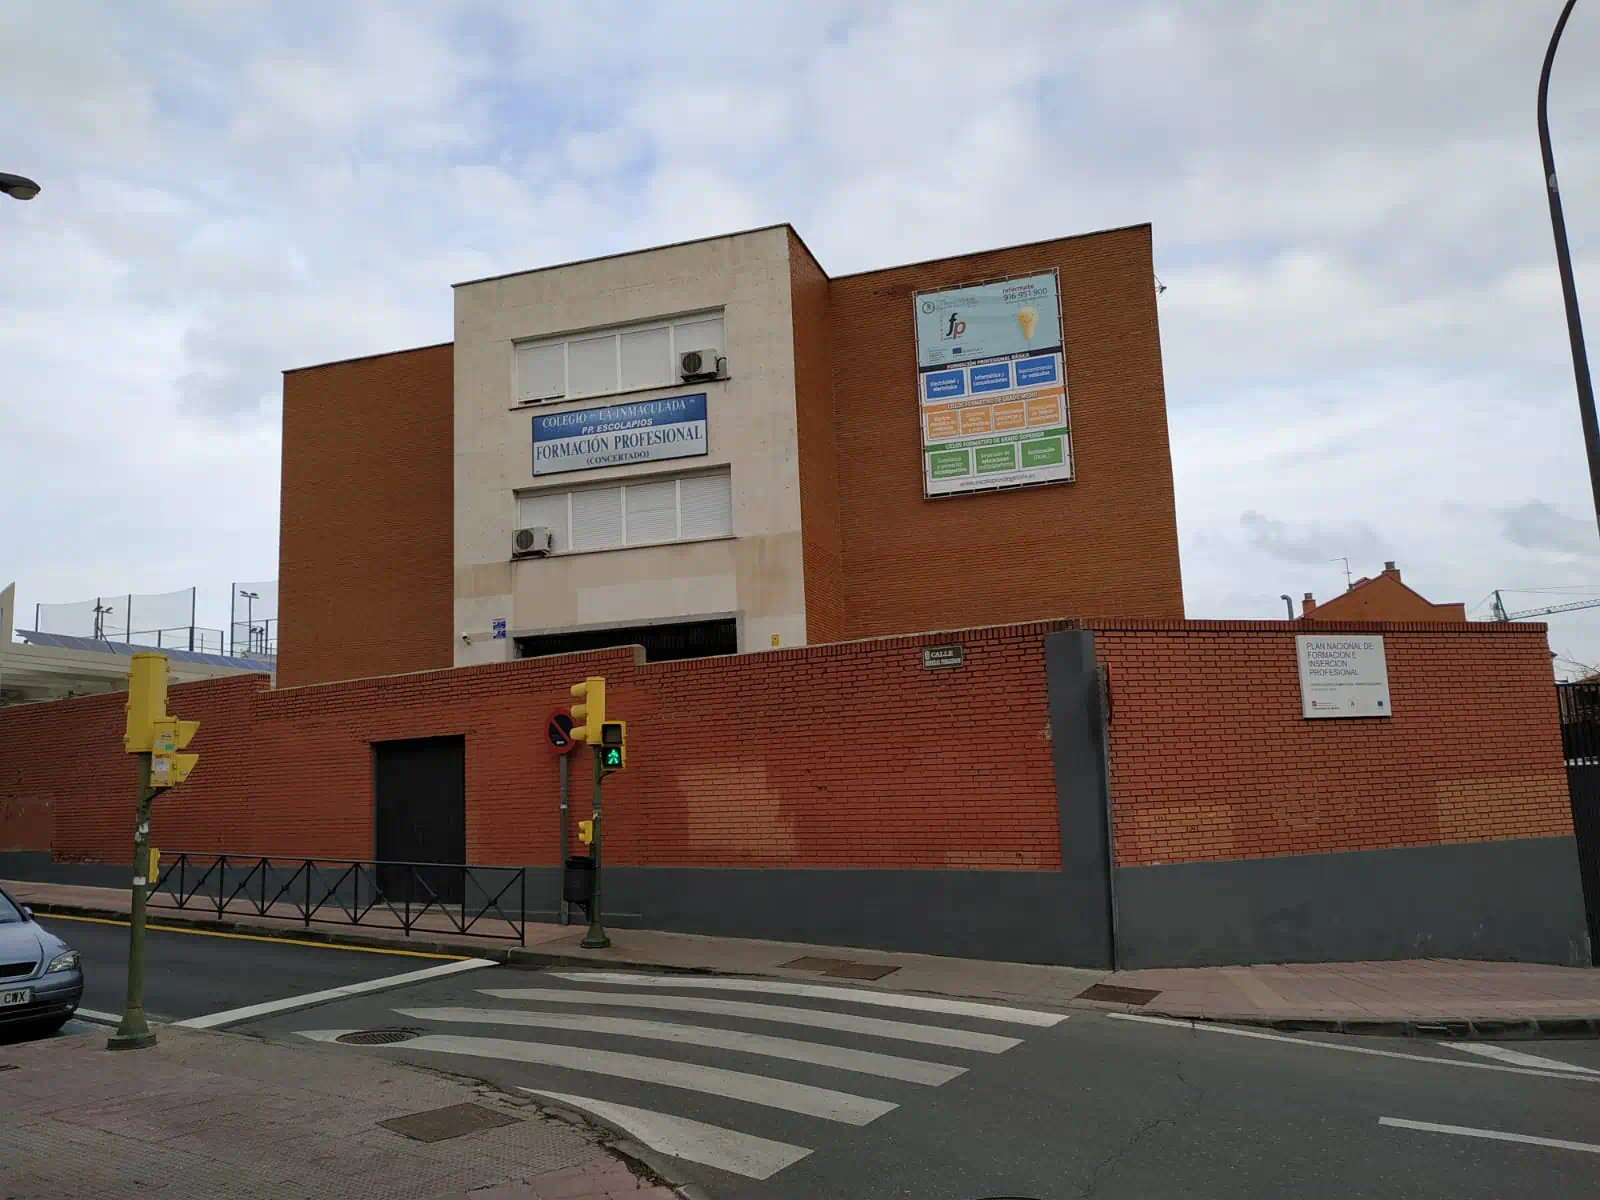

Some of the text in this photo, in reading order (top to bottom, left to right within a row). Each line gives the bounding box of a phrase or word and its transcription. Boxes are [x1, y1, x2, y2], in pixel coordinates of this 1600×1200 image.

[1018, 291, 1031, 299] 951
[1032, 288, 1047, 297] 900
[946, 312, 966, 340] fp
[542, 414, 587, 428] COLEGIO
[599, 409, 612, 420] LA
[614, 399, 686, 418] INMACULADA
[597, 419, 653, 433] ESCOLAPIOS
[536, 425, 703, 460] FORMACIÓN PROFESIONAL
[587, 450, 650, 466] (CONCERTADO)
[4, 992, 26, 1005] CWX
